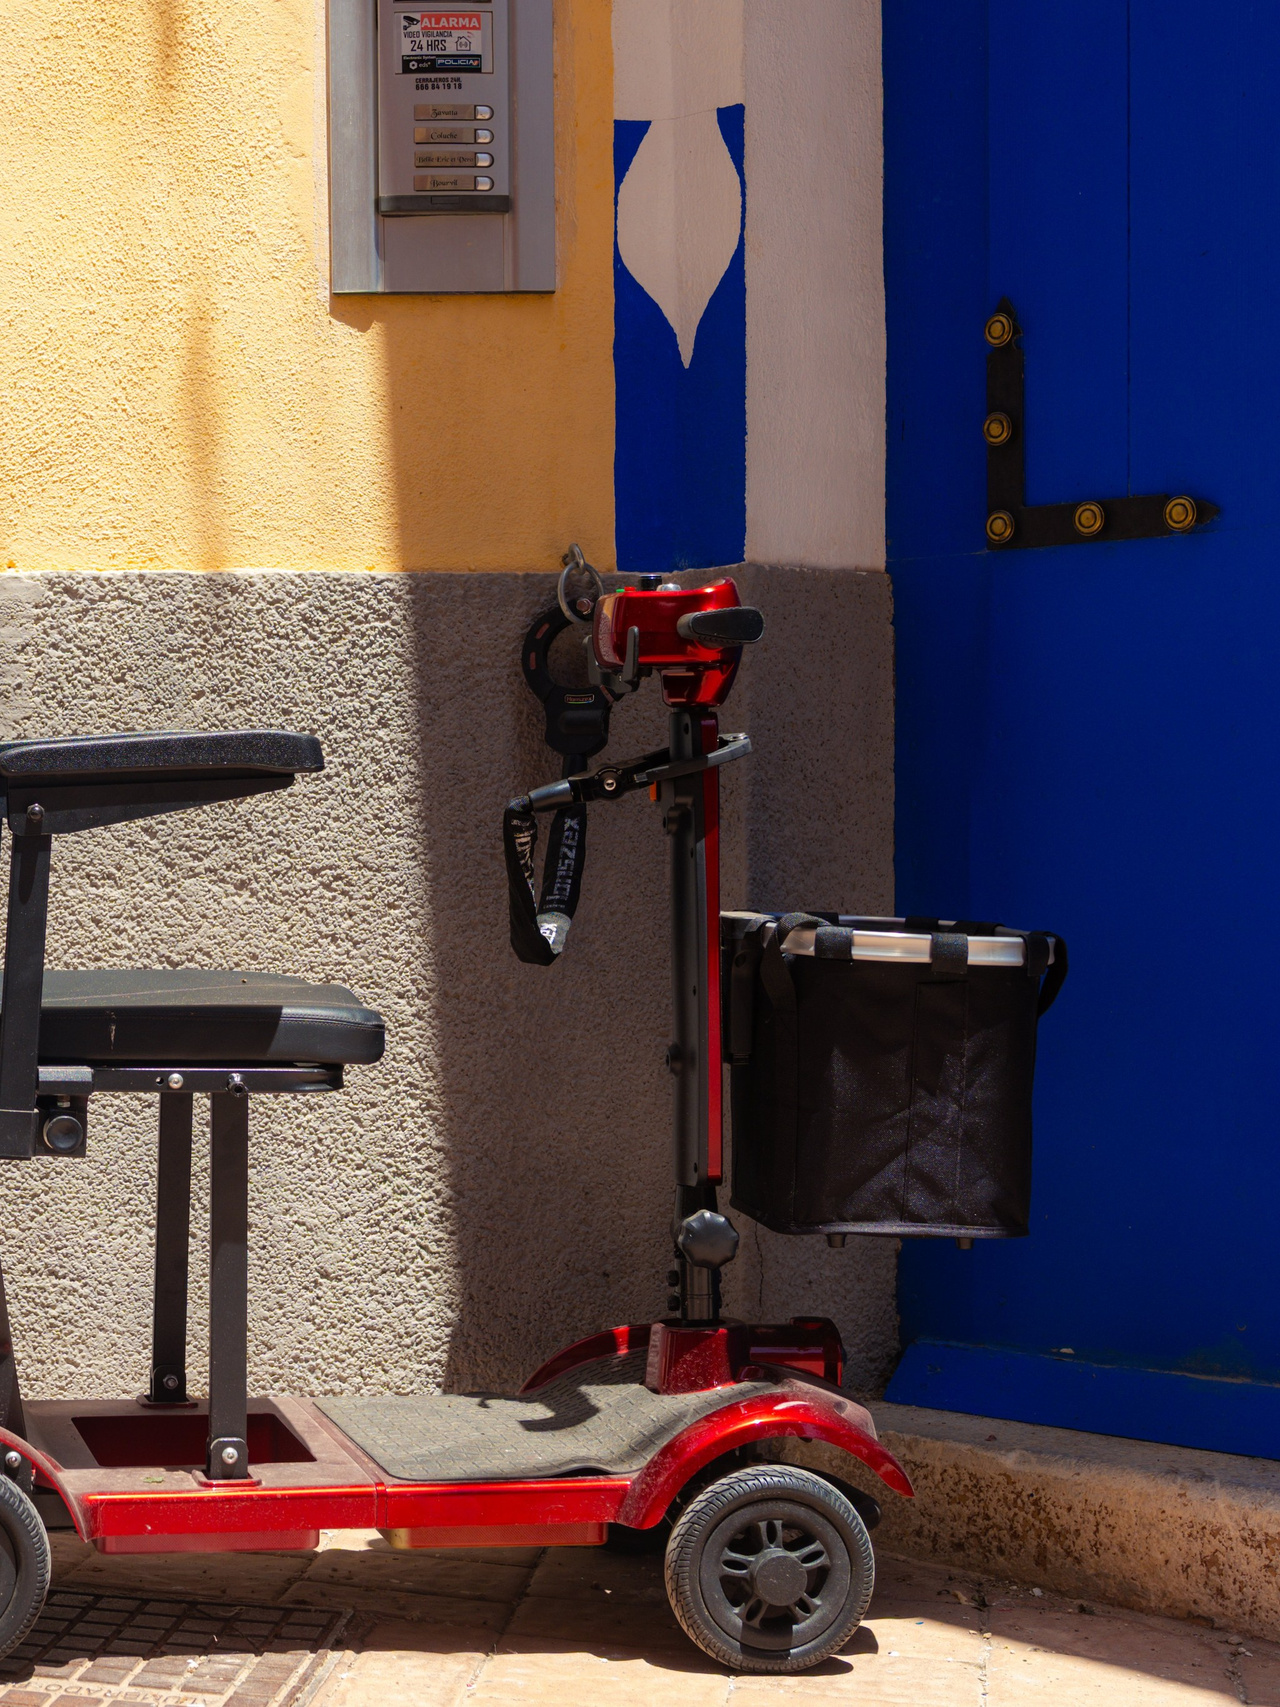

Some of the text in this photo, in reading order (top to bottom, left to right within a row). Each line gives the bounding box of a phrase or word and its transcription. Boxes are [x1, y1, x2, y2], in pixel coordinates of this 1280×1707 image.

[421, 17, 479, 28] ALARMA
[403, 31, 420, 39] VIDEO
[410, 39, 447, 52] 24 HRS
[453, 82, 462, 90] 18
[430, 131, 458, 141] Coluche
